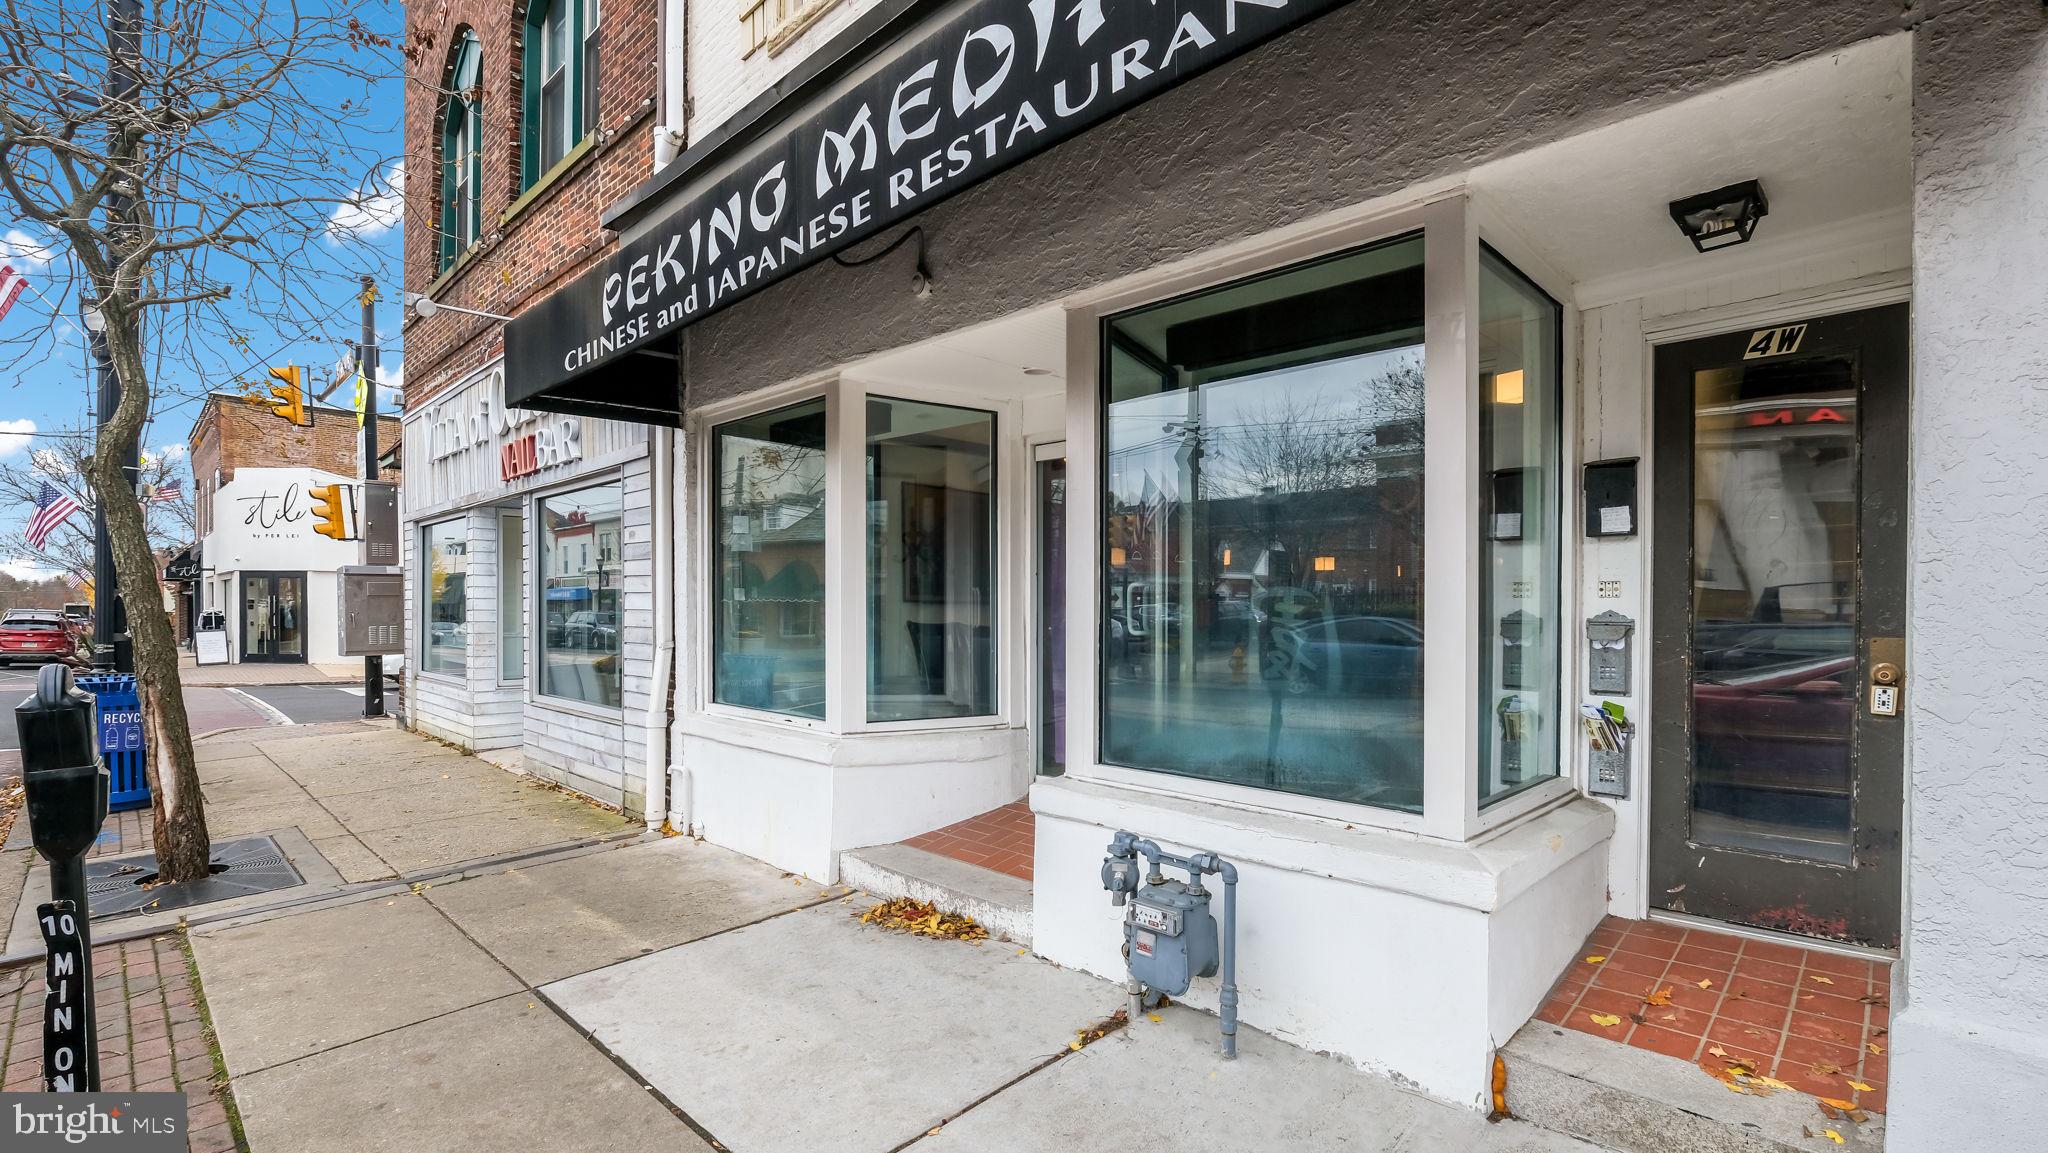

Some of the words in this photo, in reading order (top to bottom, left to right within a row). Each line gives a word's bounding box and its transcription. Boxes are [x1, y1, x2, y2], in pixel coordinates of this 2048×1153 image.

[602, 160, 787, 326] PEKING
[564, 313, 650, 372] CHINESE
[656, 289, 698, 329] and
[708, 190, 872, 307] JAPANESE
[1748, 326, 1805, 355] 4W
[236, 483, 307, 529] stile
[103, 713, 143, 724] RECYC
[41, 914, 75, 936] 10
[53, 952, 74, 1032] MIN
